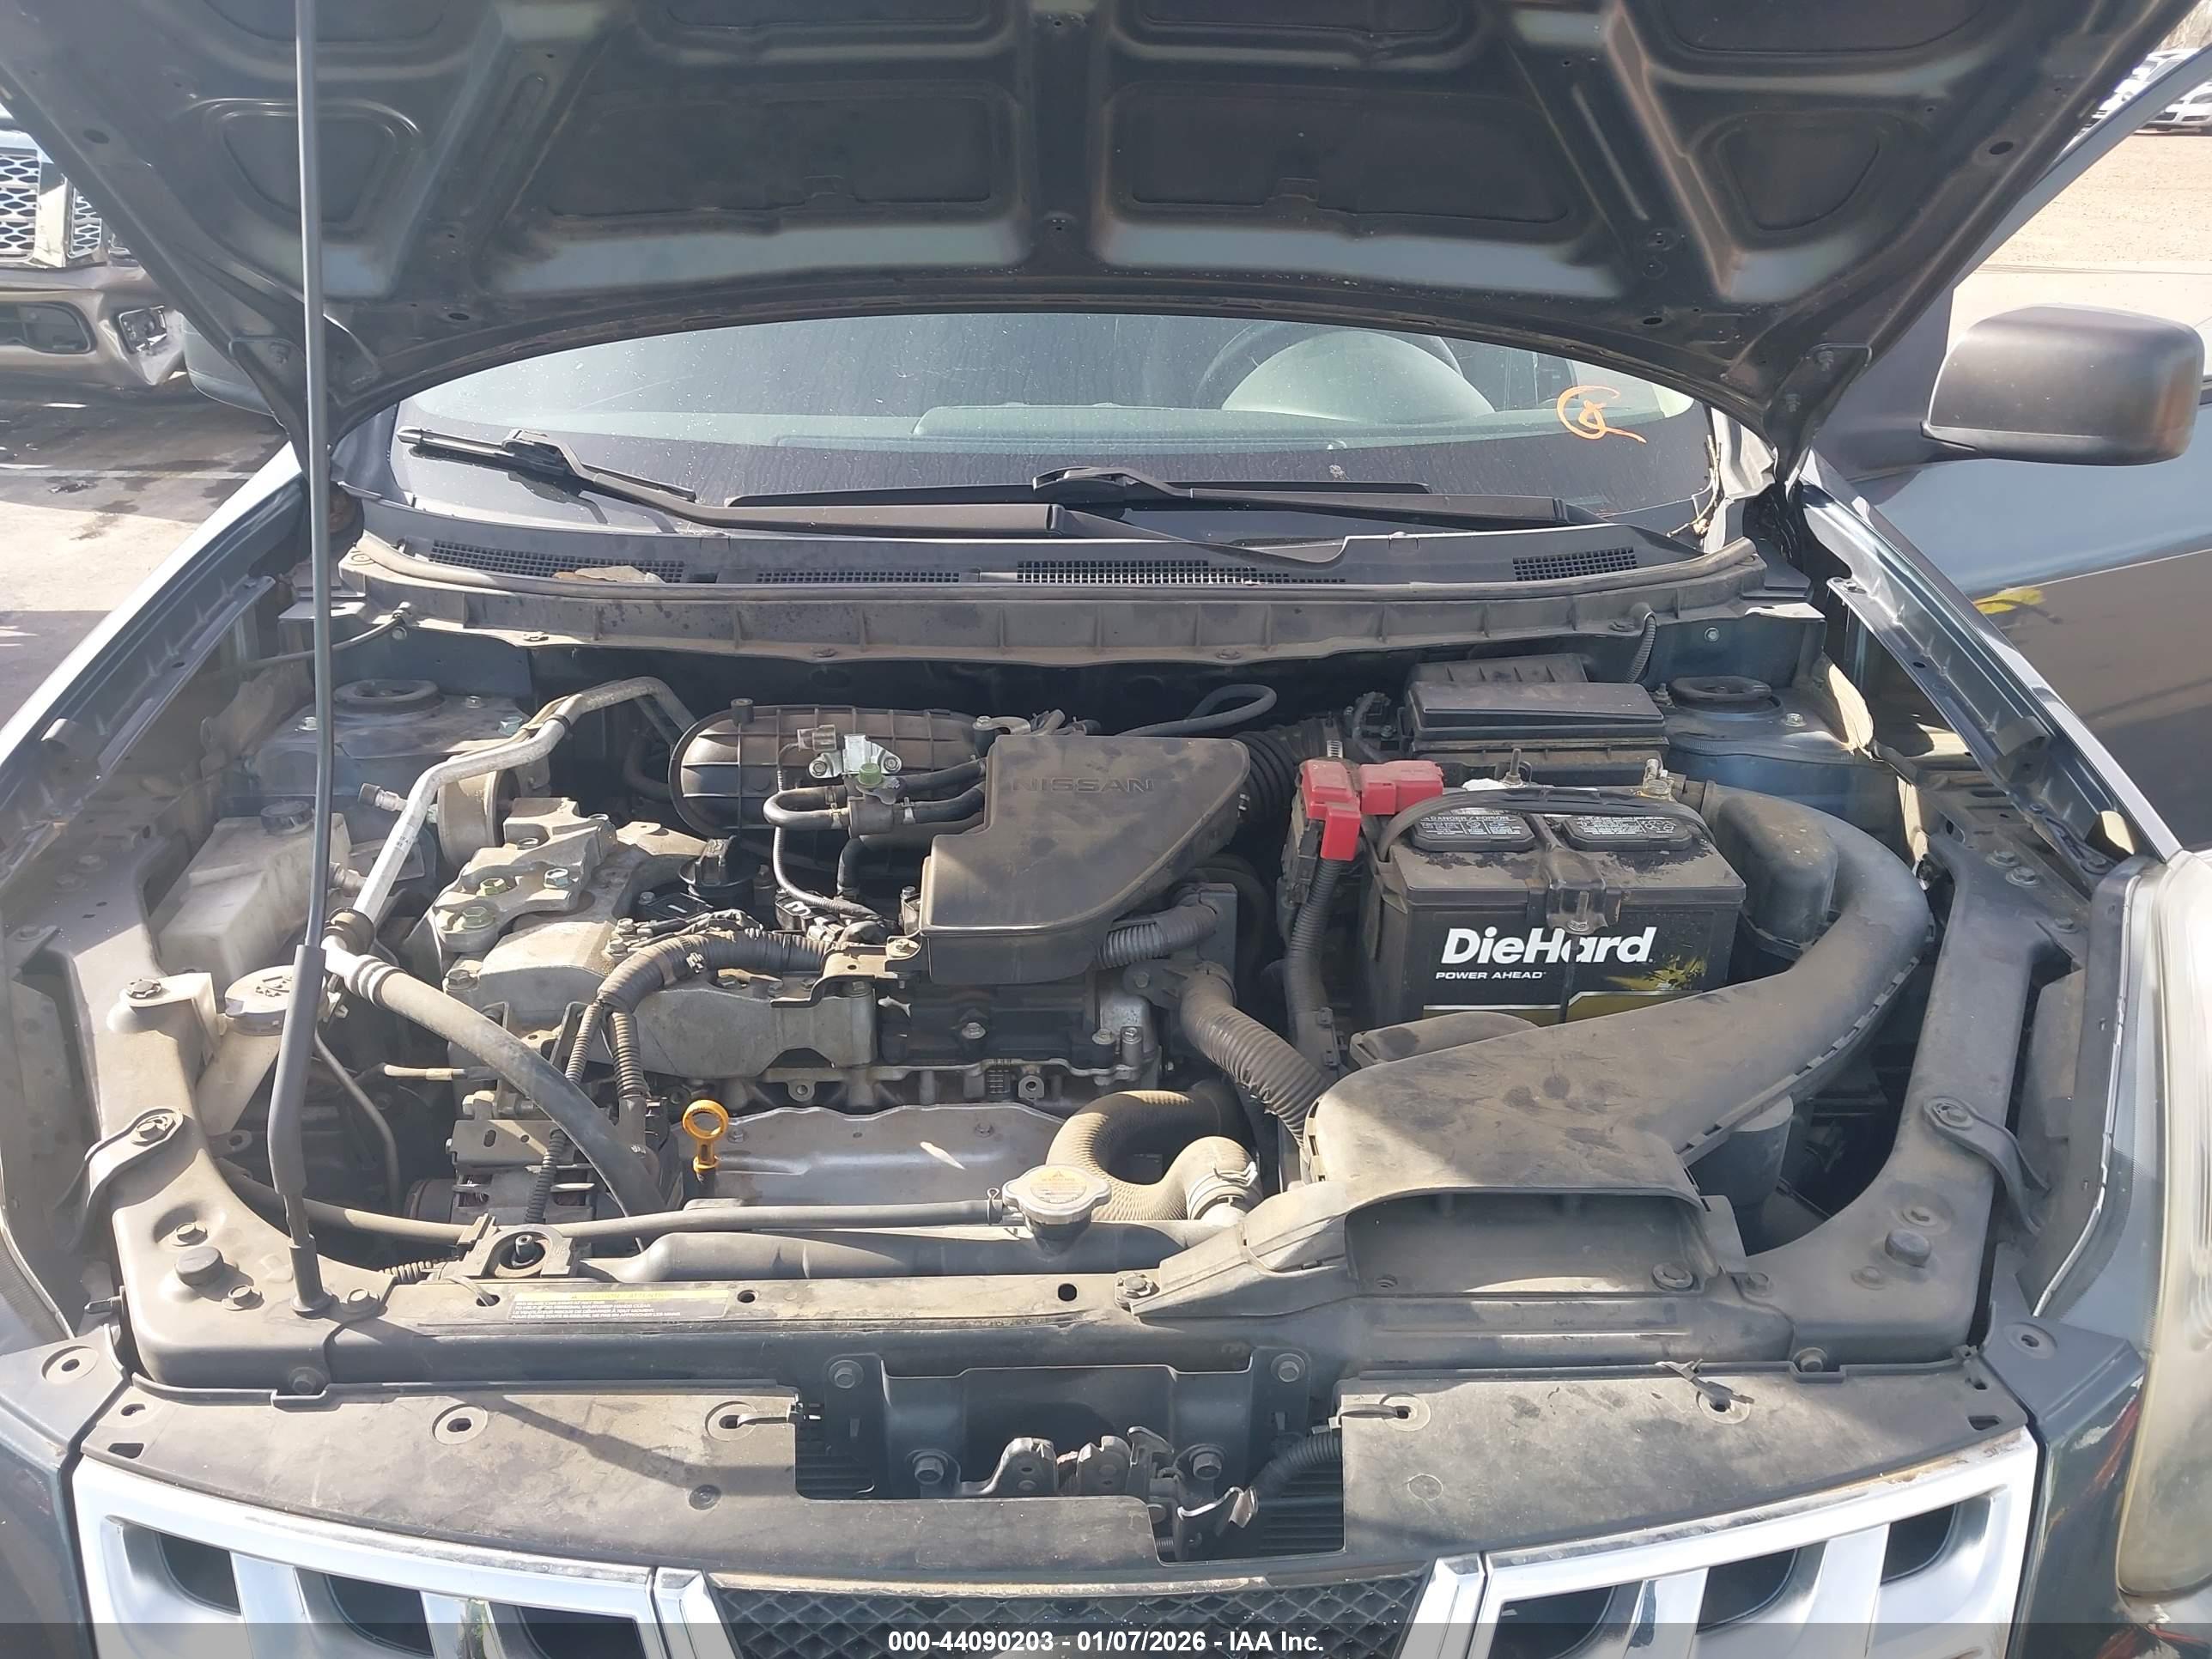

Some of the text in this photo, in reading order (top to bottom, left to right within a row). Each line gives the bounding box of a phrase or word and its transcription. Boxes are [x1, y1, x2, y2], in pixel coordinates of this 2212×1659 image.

[1011, 777, 1154, 793] NISSAN
[1441, 927, 1657, 964] DieHard
[1436, 971, 1543, 980] POWER AHEAD
